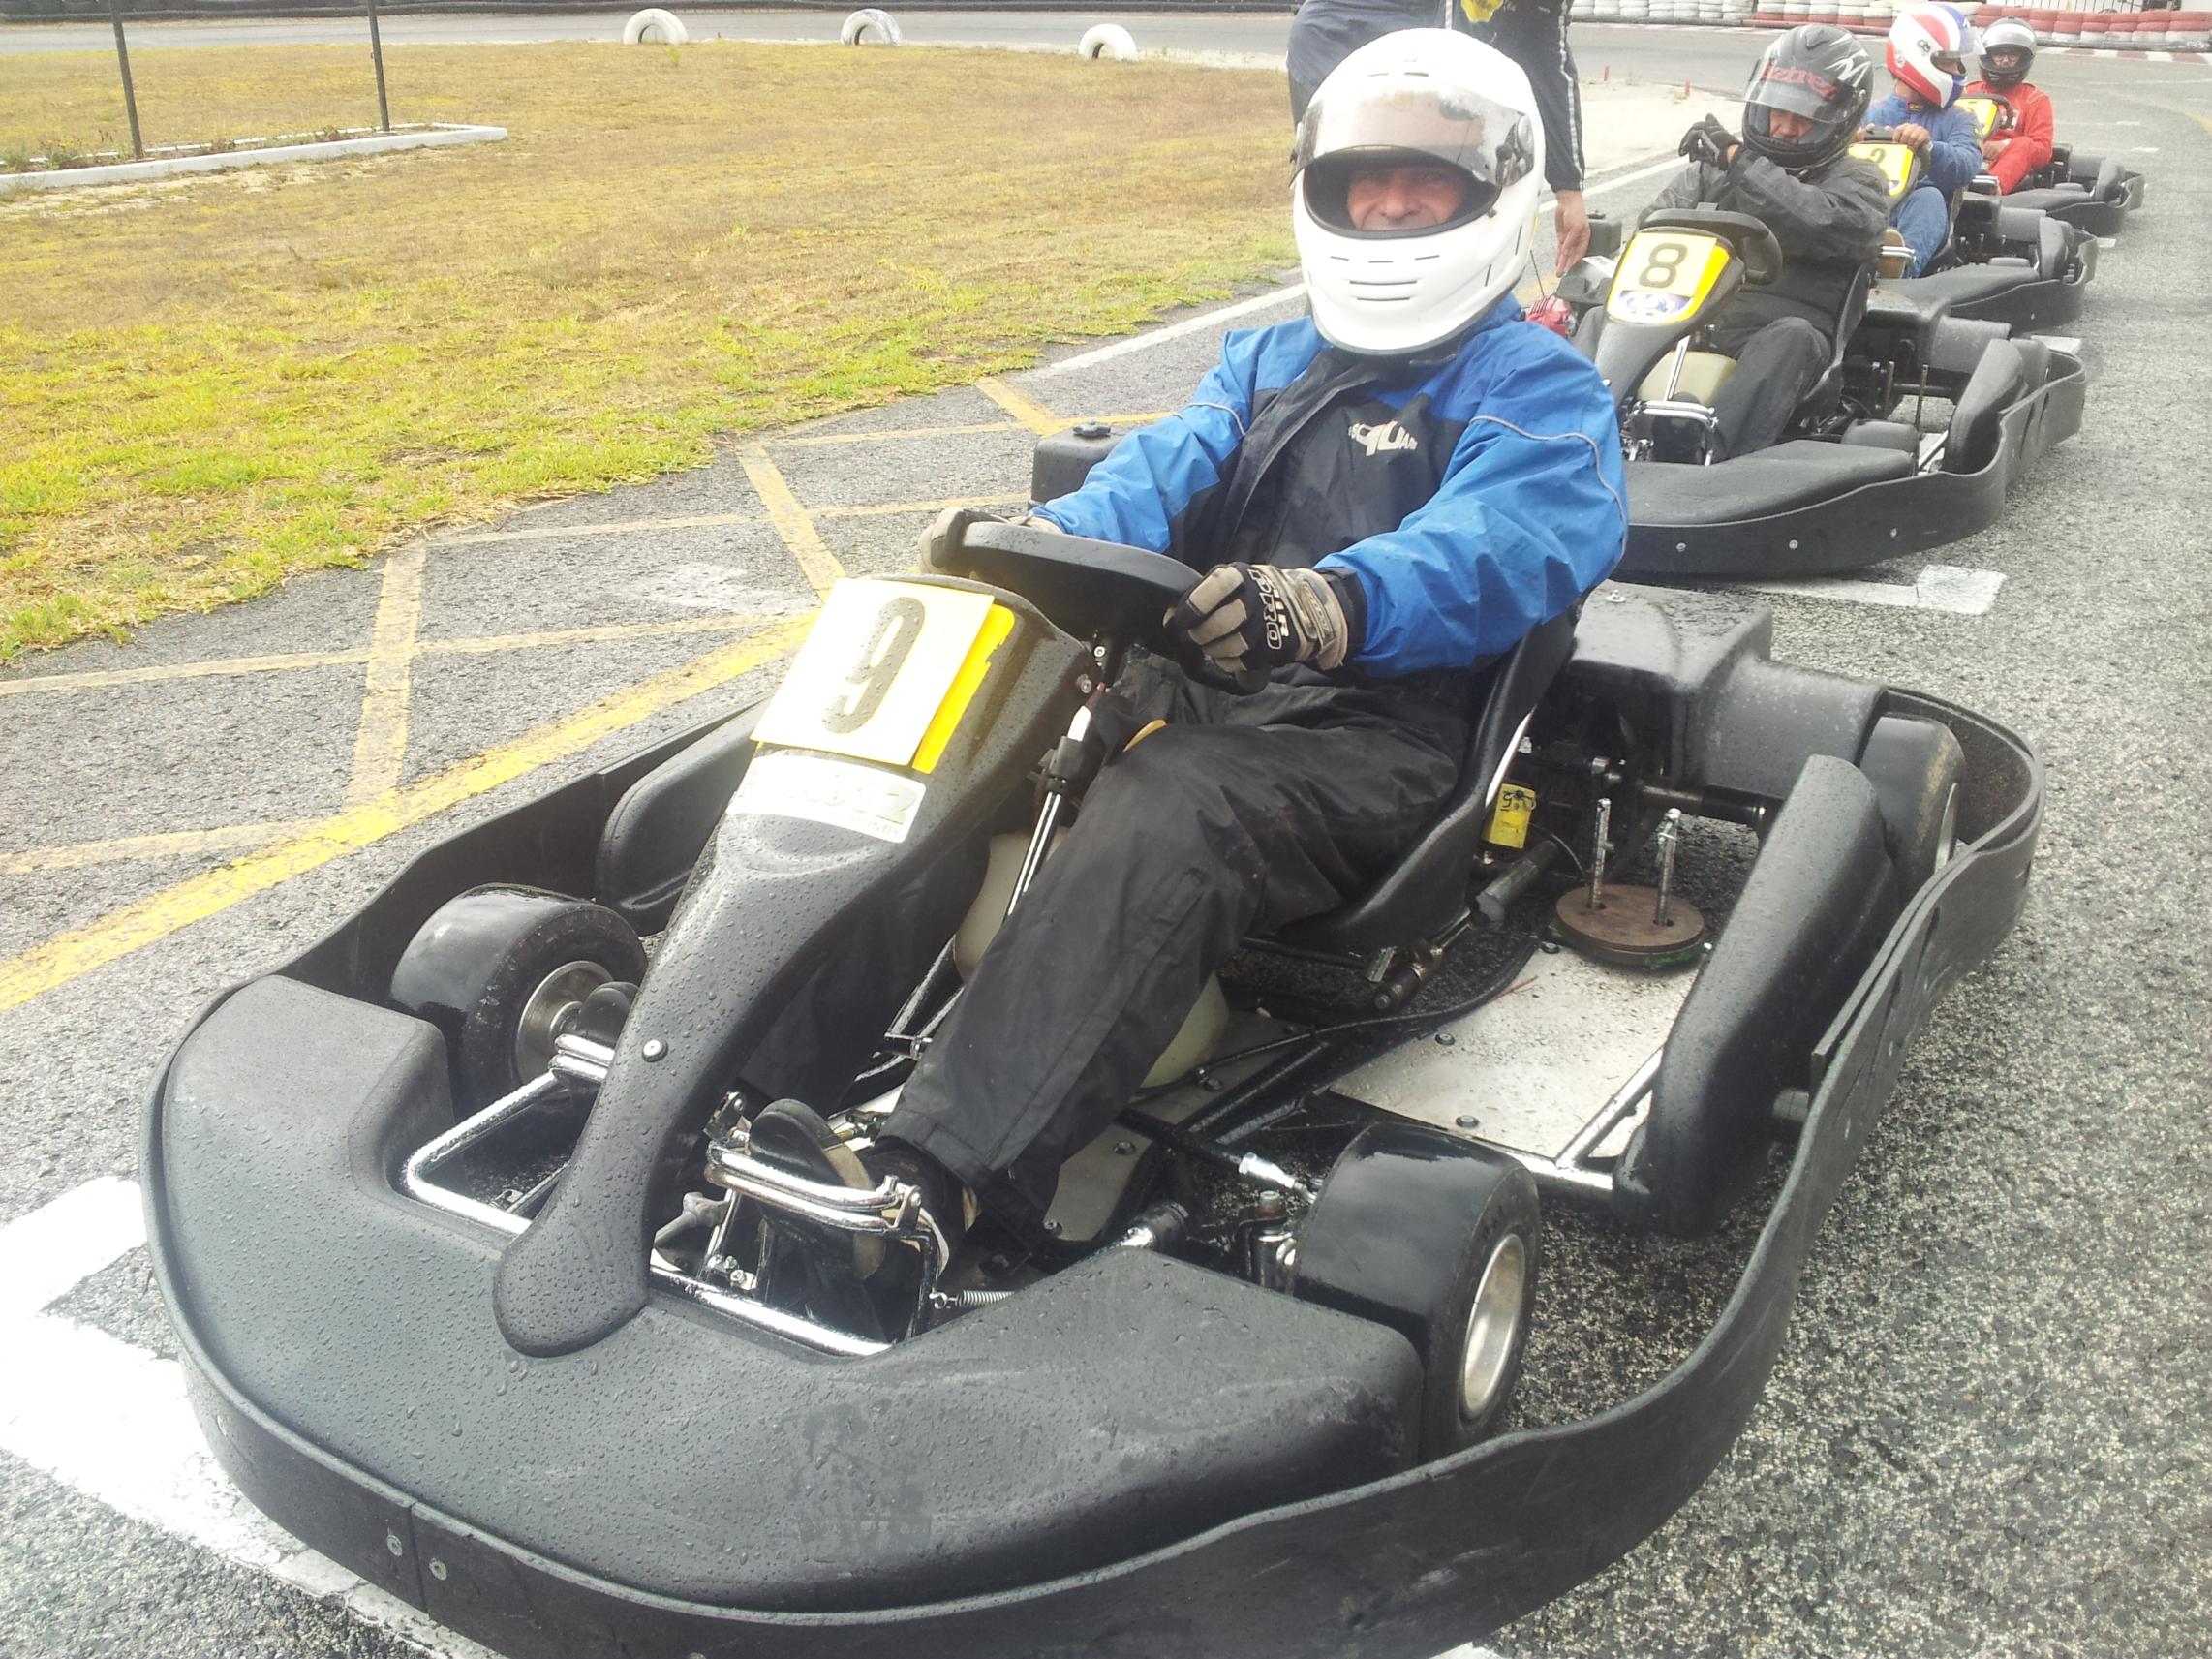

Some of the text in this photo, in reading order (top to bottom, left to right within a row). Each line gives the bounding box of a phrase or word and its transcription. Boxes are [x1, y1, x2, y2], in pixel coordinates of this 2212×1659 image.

[1638, 242, 1688, 289] 8
[1248, 569, 1282, 650] PRO
[821, 596, 926, 735] 9
